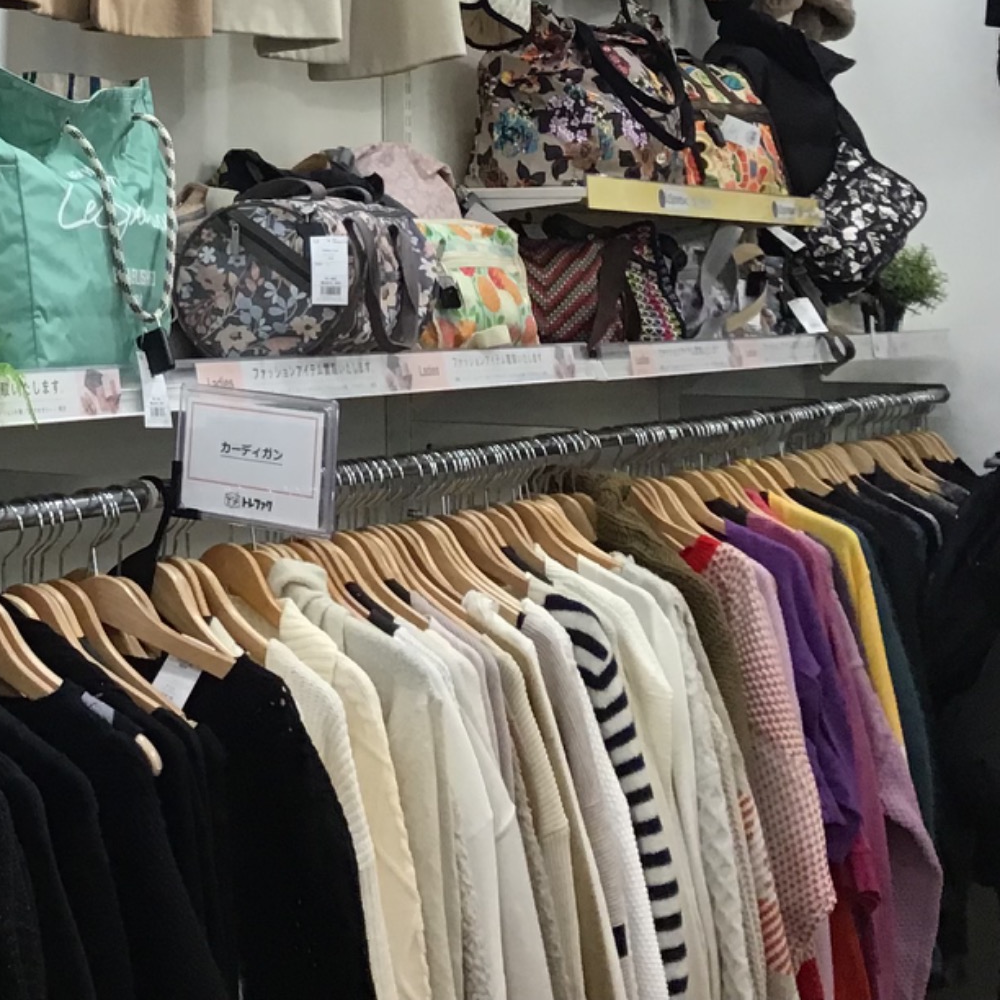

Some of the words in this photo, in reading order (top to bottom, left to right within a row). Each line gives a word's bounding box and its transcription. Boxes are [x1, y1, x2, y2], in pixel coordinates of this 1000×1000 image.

[220, 441, 283, 461] カーディガン
